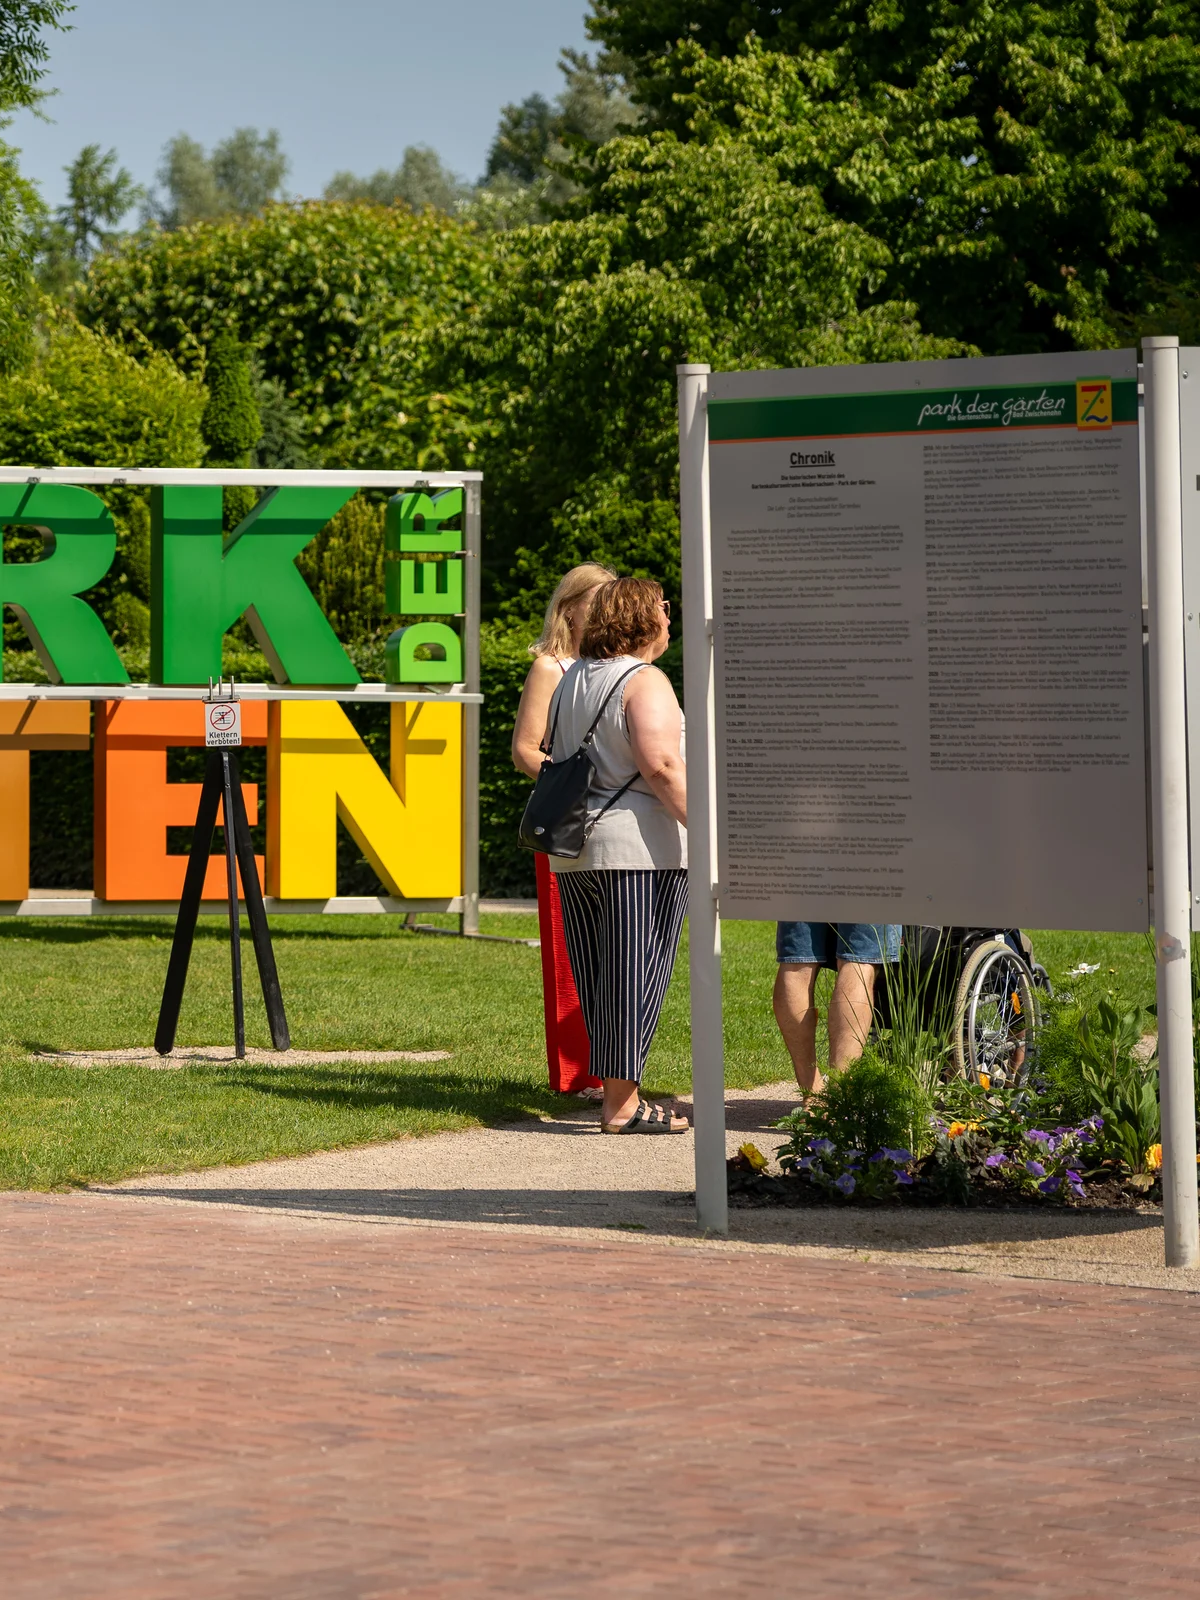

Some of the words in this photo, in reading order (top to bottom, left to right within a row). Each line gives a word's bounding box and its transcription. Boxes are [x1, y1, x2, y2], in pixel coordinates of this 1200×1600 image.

[917, 394, 962, 425] park
[967, 393, 998, 412] der
[1002, 389, 1065, 425] gärten
[958, 413, 992, 421] Gartenschau
[790, 451, 835, 465] Chronik
[386, 487, 463, 684] DER
